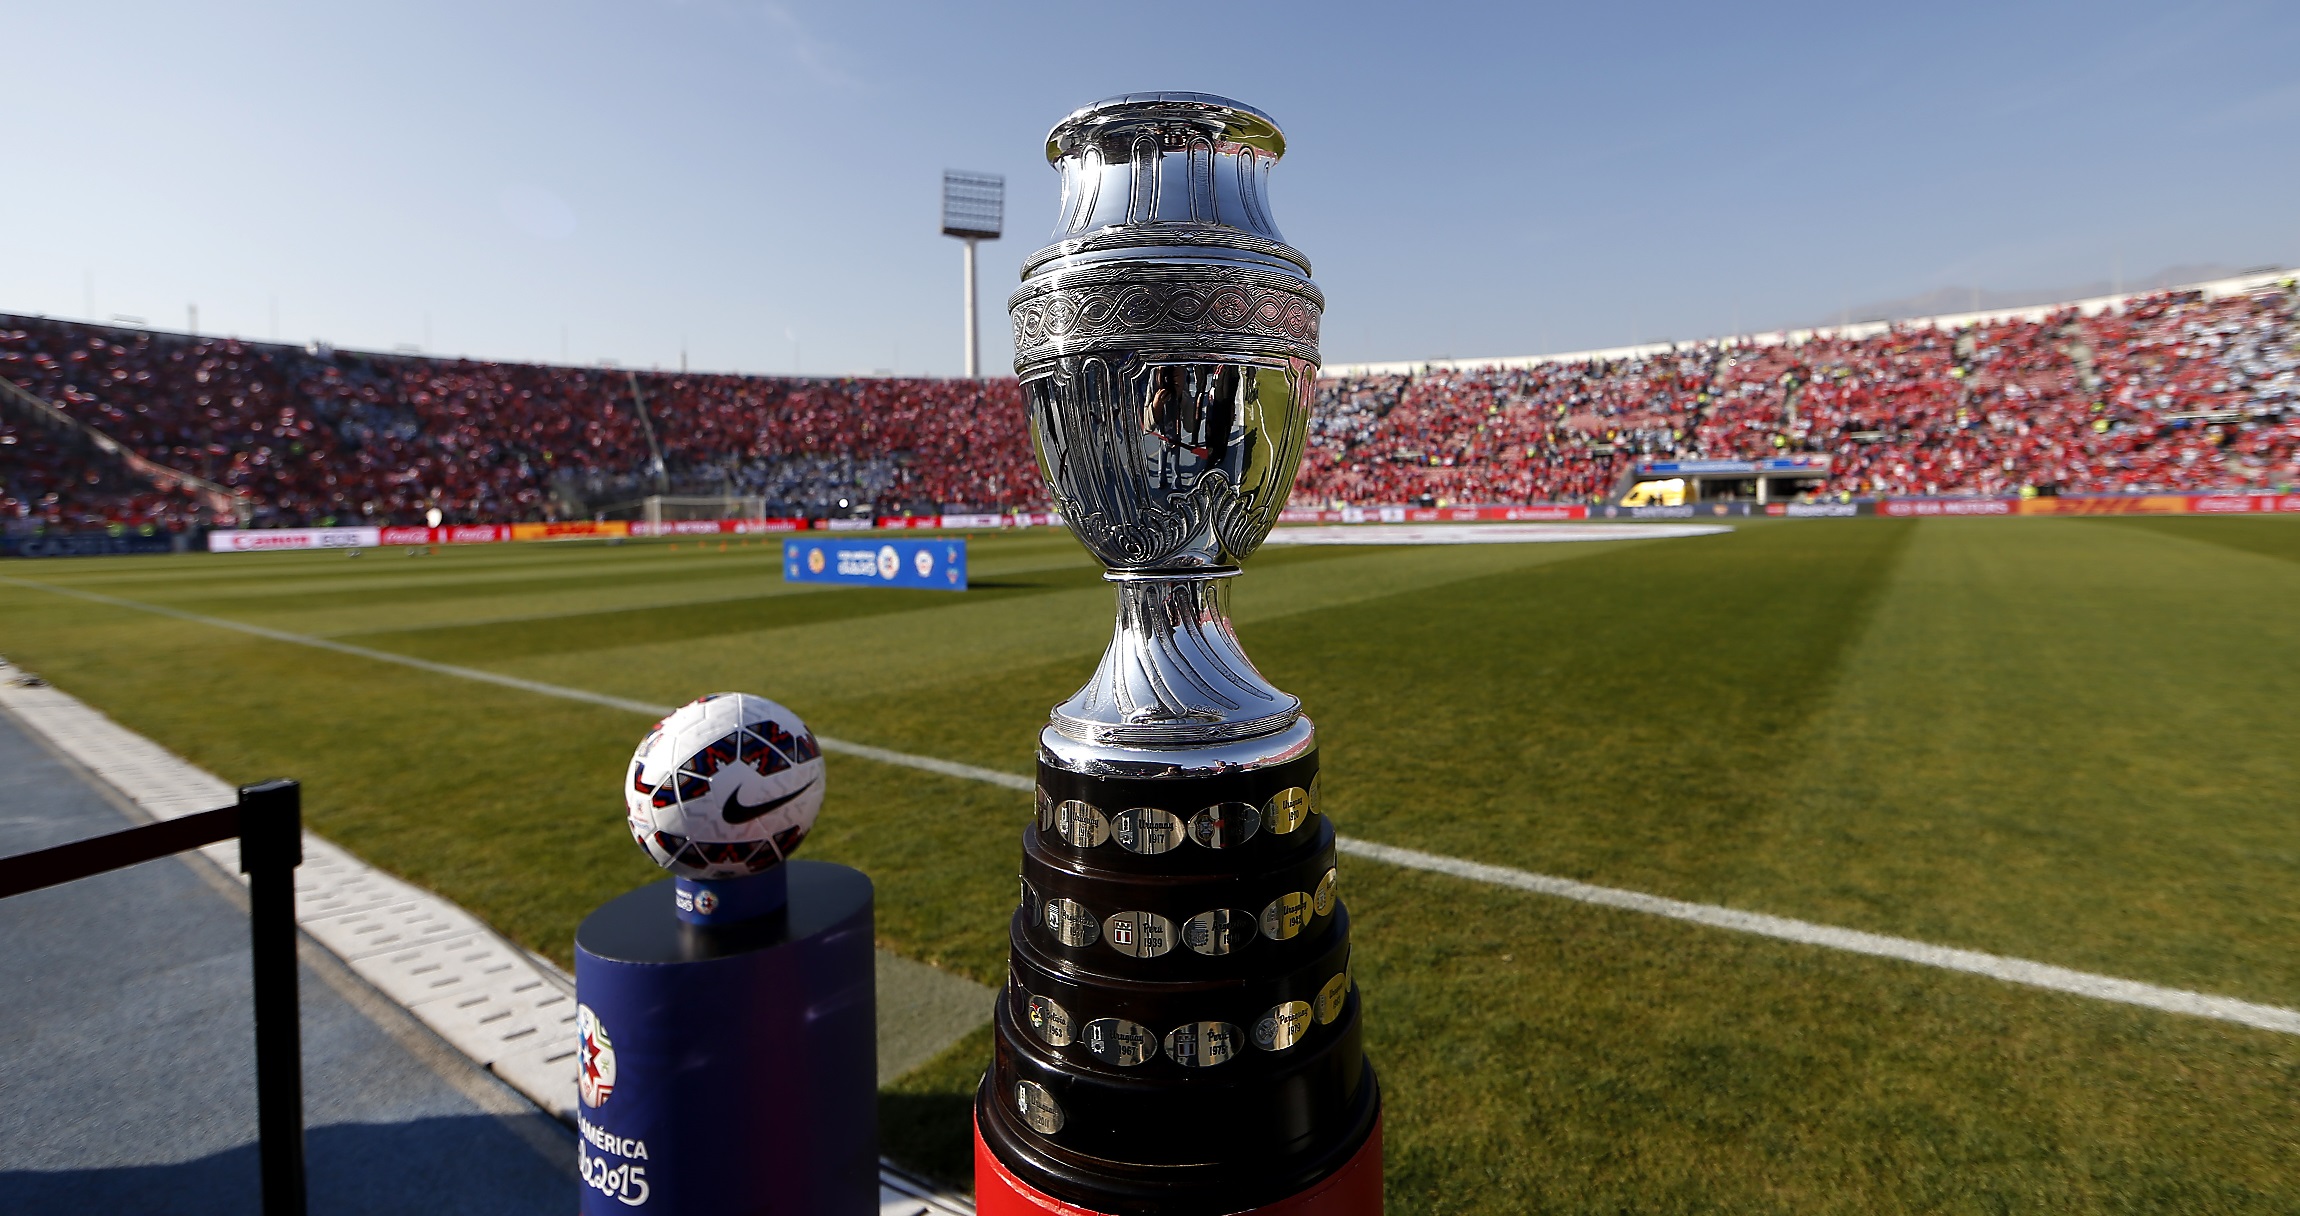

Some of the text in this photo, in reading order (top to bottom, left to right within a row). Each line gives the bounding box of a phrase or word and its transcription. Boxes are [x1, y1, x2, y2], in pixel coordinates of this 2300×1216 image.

[1138, 819, 1174, 832] Uruguay
[1149, 834, 1165, 844] 1917
[1143, 937, 1163, 948] 1939
[1110, 1029, 1144, 1045] Uruguay
[1119, 1045, 1136, 1056] 1967
